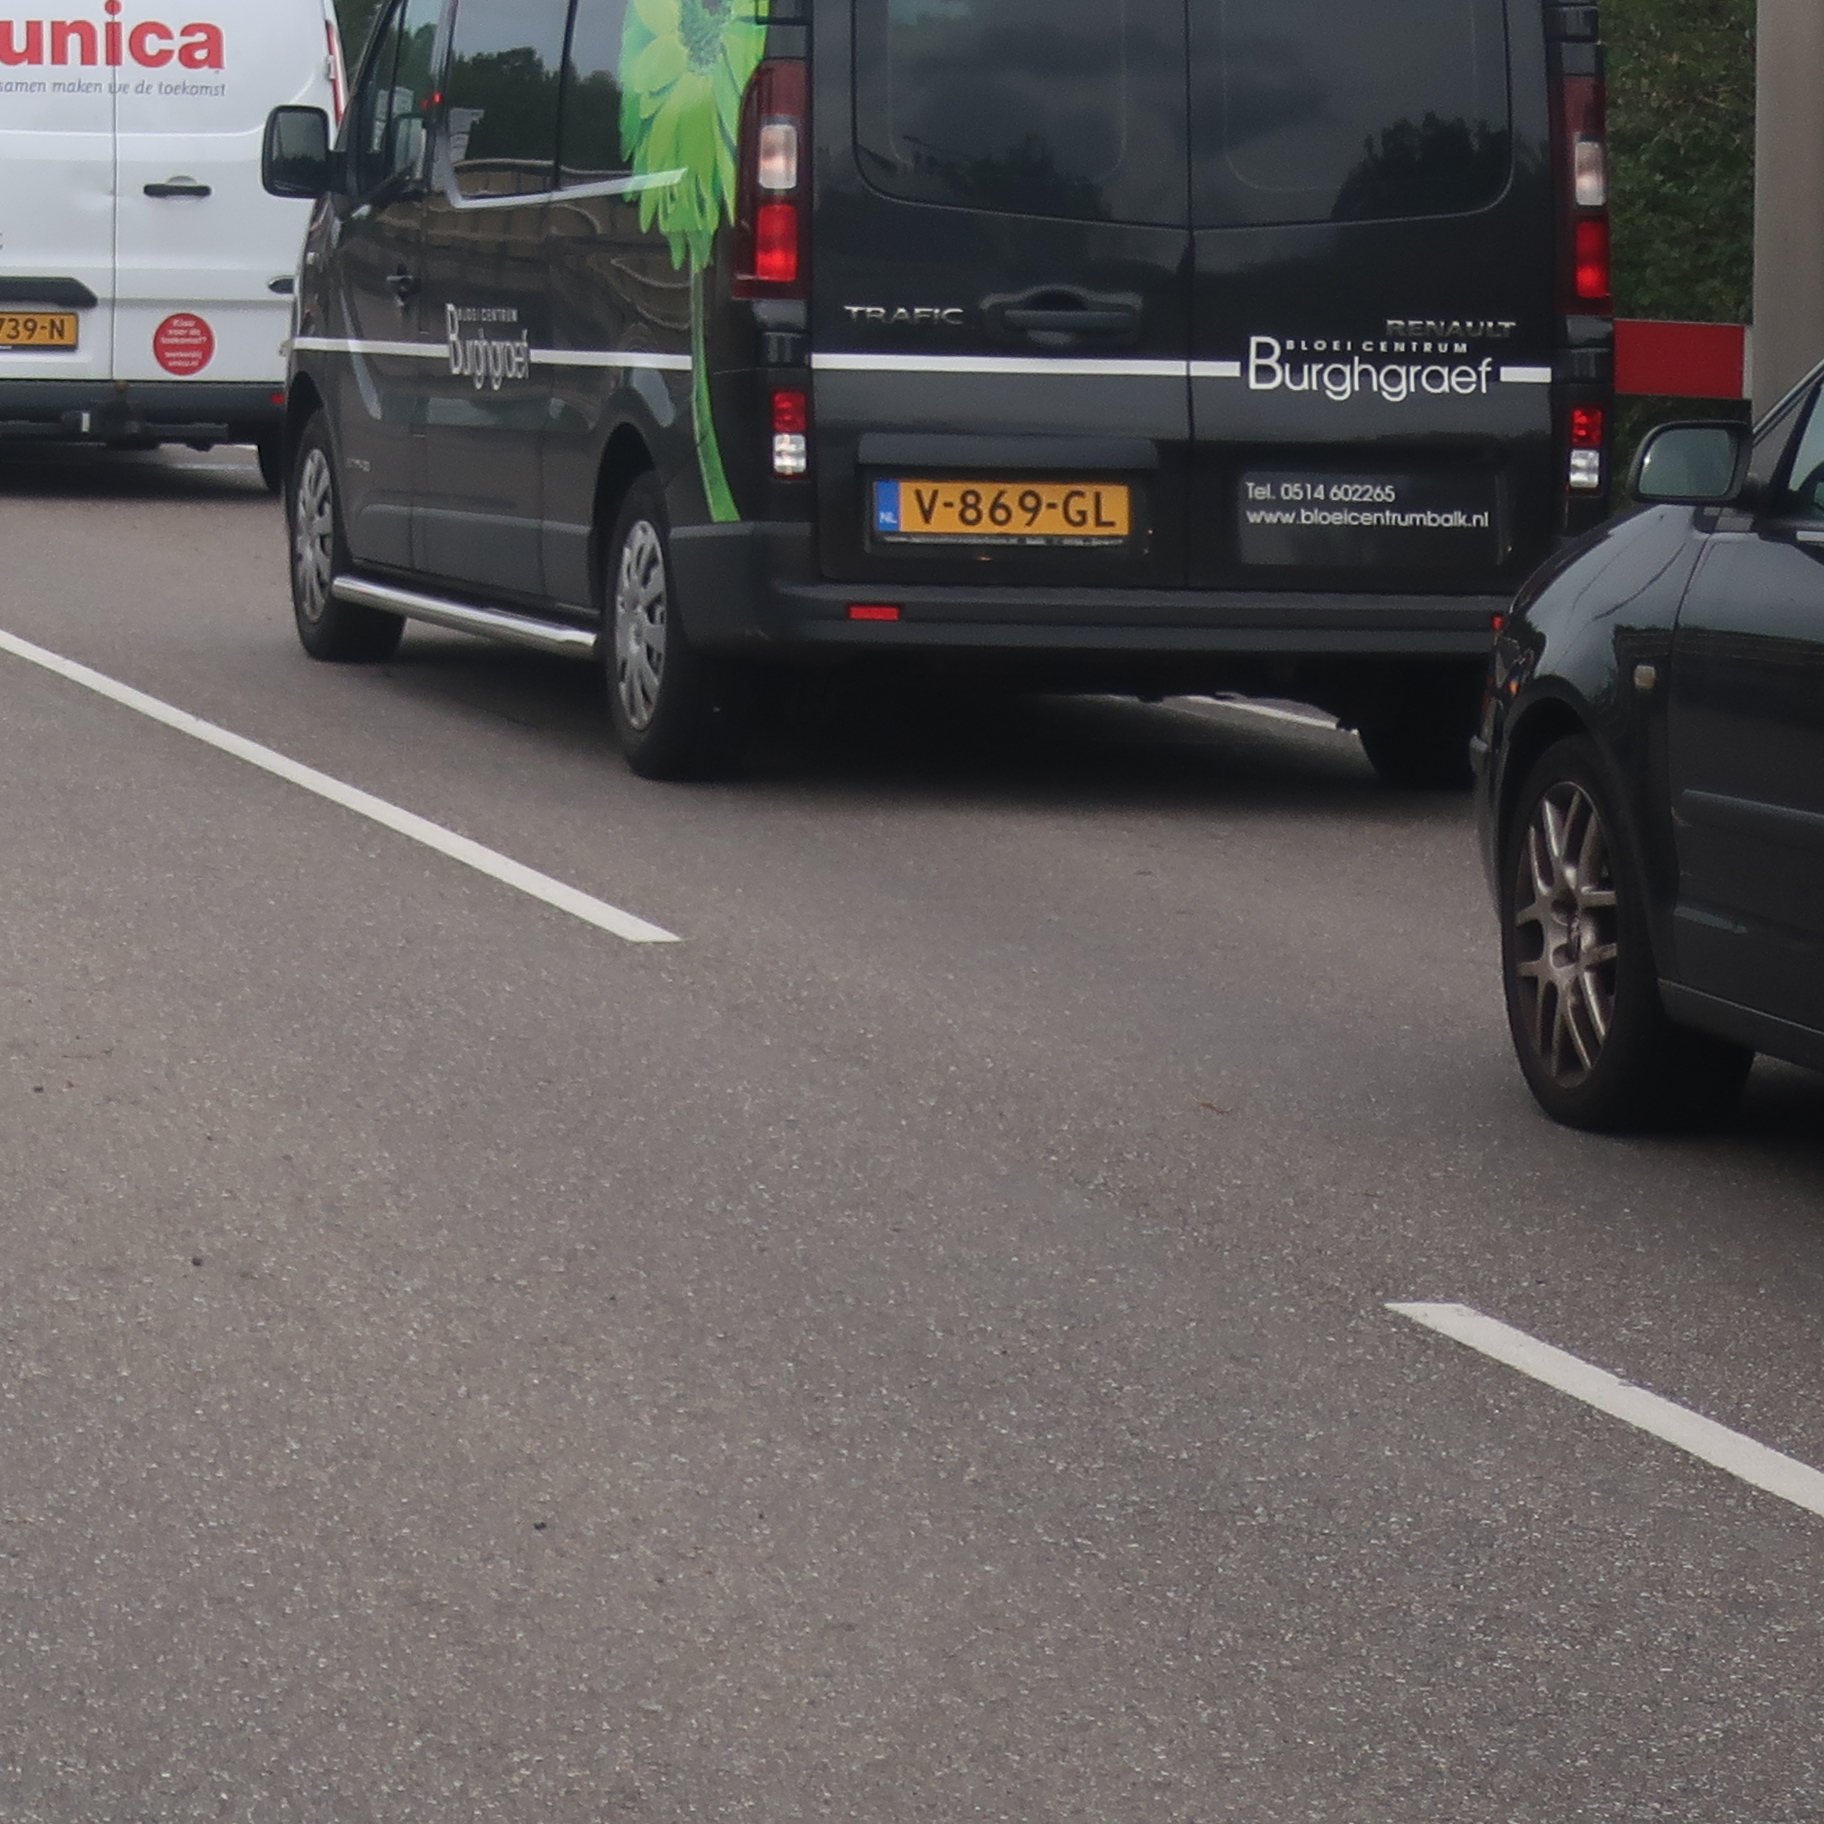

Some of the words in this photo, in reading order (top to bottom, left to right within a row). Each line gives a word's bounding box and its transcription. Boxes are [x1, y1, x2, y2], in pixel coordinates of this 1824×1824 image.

[51, 77, 102, 94] maken
[135, 79, 153, 95] de
[158, 79, 226, 97] toekomst
[844, 306, 964, 324] TRAFIC
[1385, 320, 1516, 337] RENAULT
[1249, 336, 1492, 401] Burghgraef
[1246, 482, 1275, 499] Tel.
[1281, 484, 1324, 500] 0514
[1330, 485, 1395, 502] 602265
[915, 489, 1116, 527] V-869-GL
[1247, 509, 1489, 527] www.bloeicentrumbalk.nl
